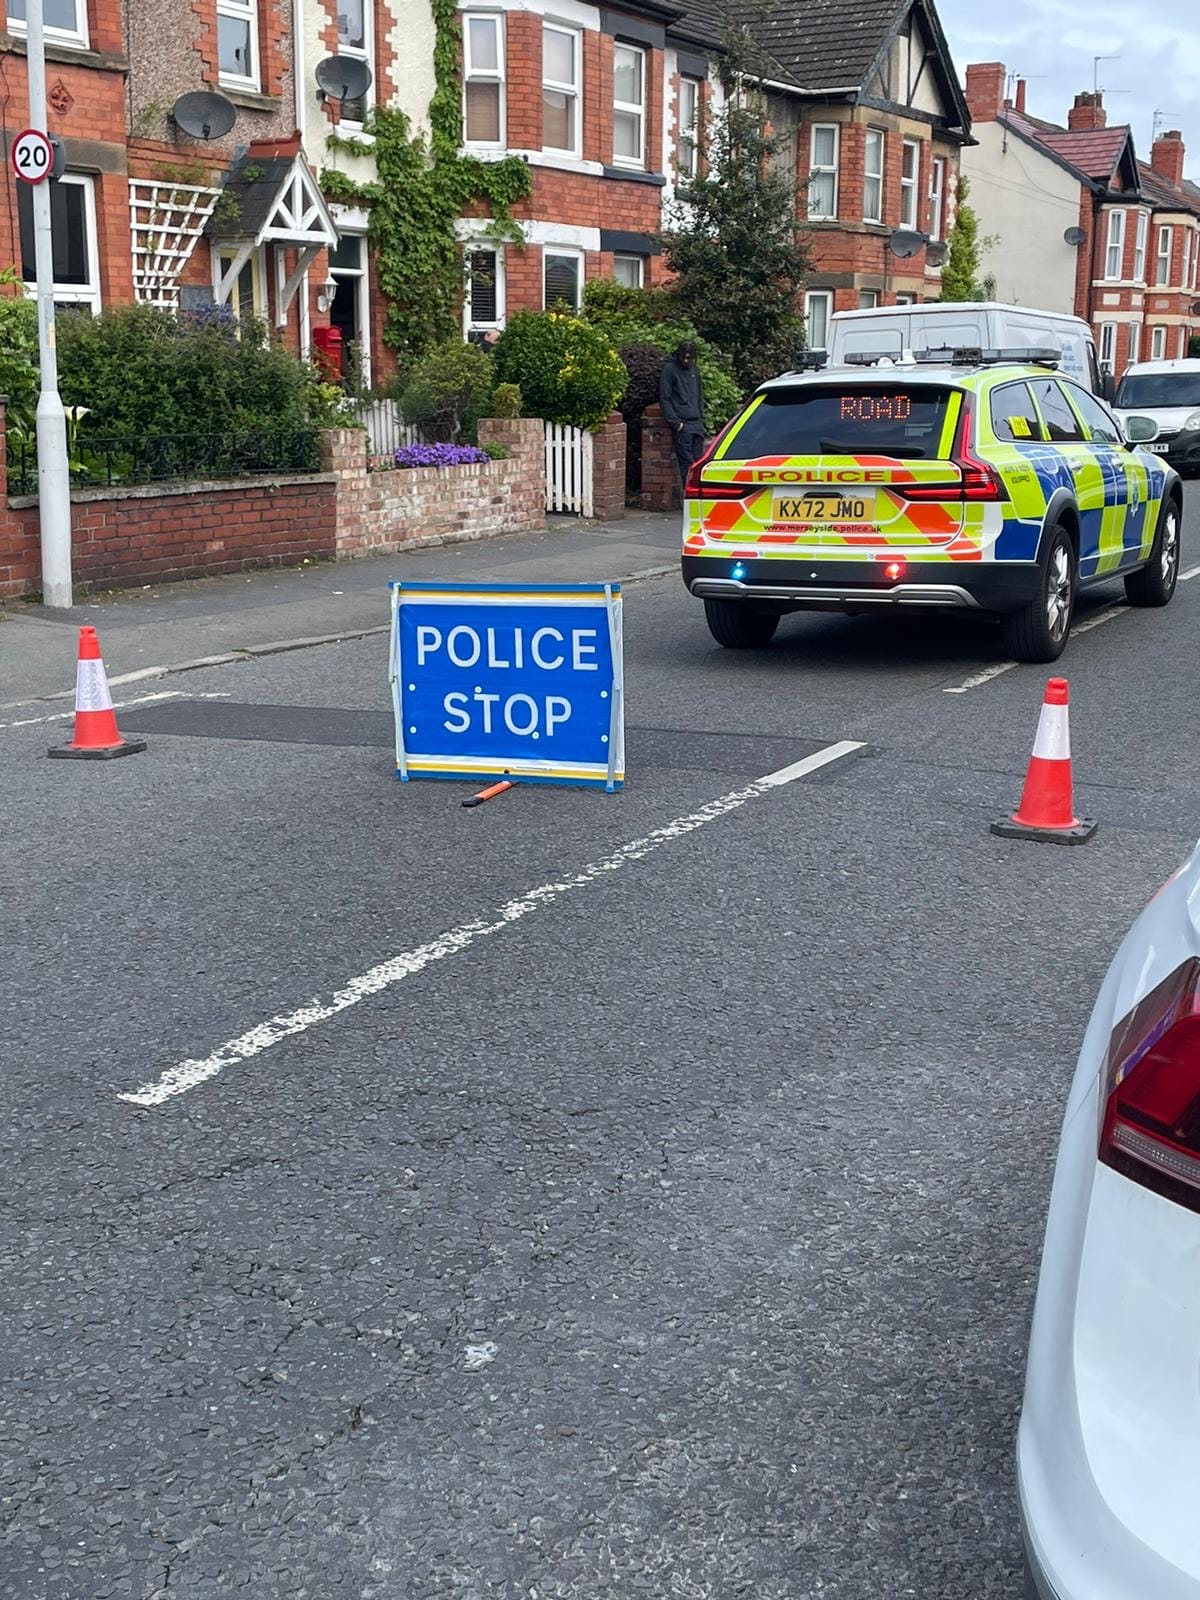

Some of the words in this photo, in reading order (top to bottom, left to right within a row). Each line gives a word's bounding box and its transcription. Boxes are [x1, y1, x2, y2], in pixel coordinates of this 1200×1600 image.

[18, 145, 47, 167] 20
[840, 395, 911, 419] ROAD
[757, 470, 885, 482] POLICE
[779, 500, 825, 517] KX72
[830, 500, 865, 518] JMO
[763, 524, 882, 533] www.merseyside.police.uk
[416, 625, 599, 671] POLICE
[443, 692, 572, 736] STOP
